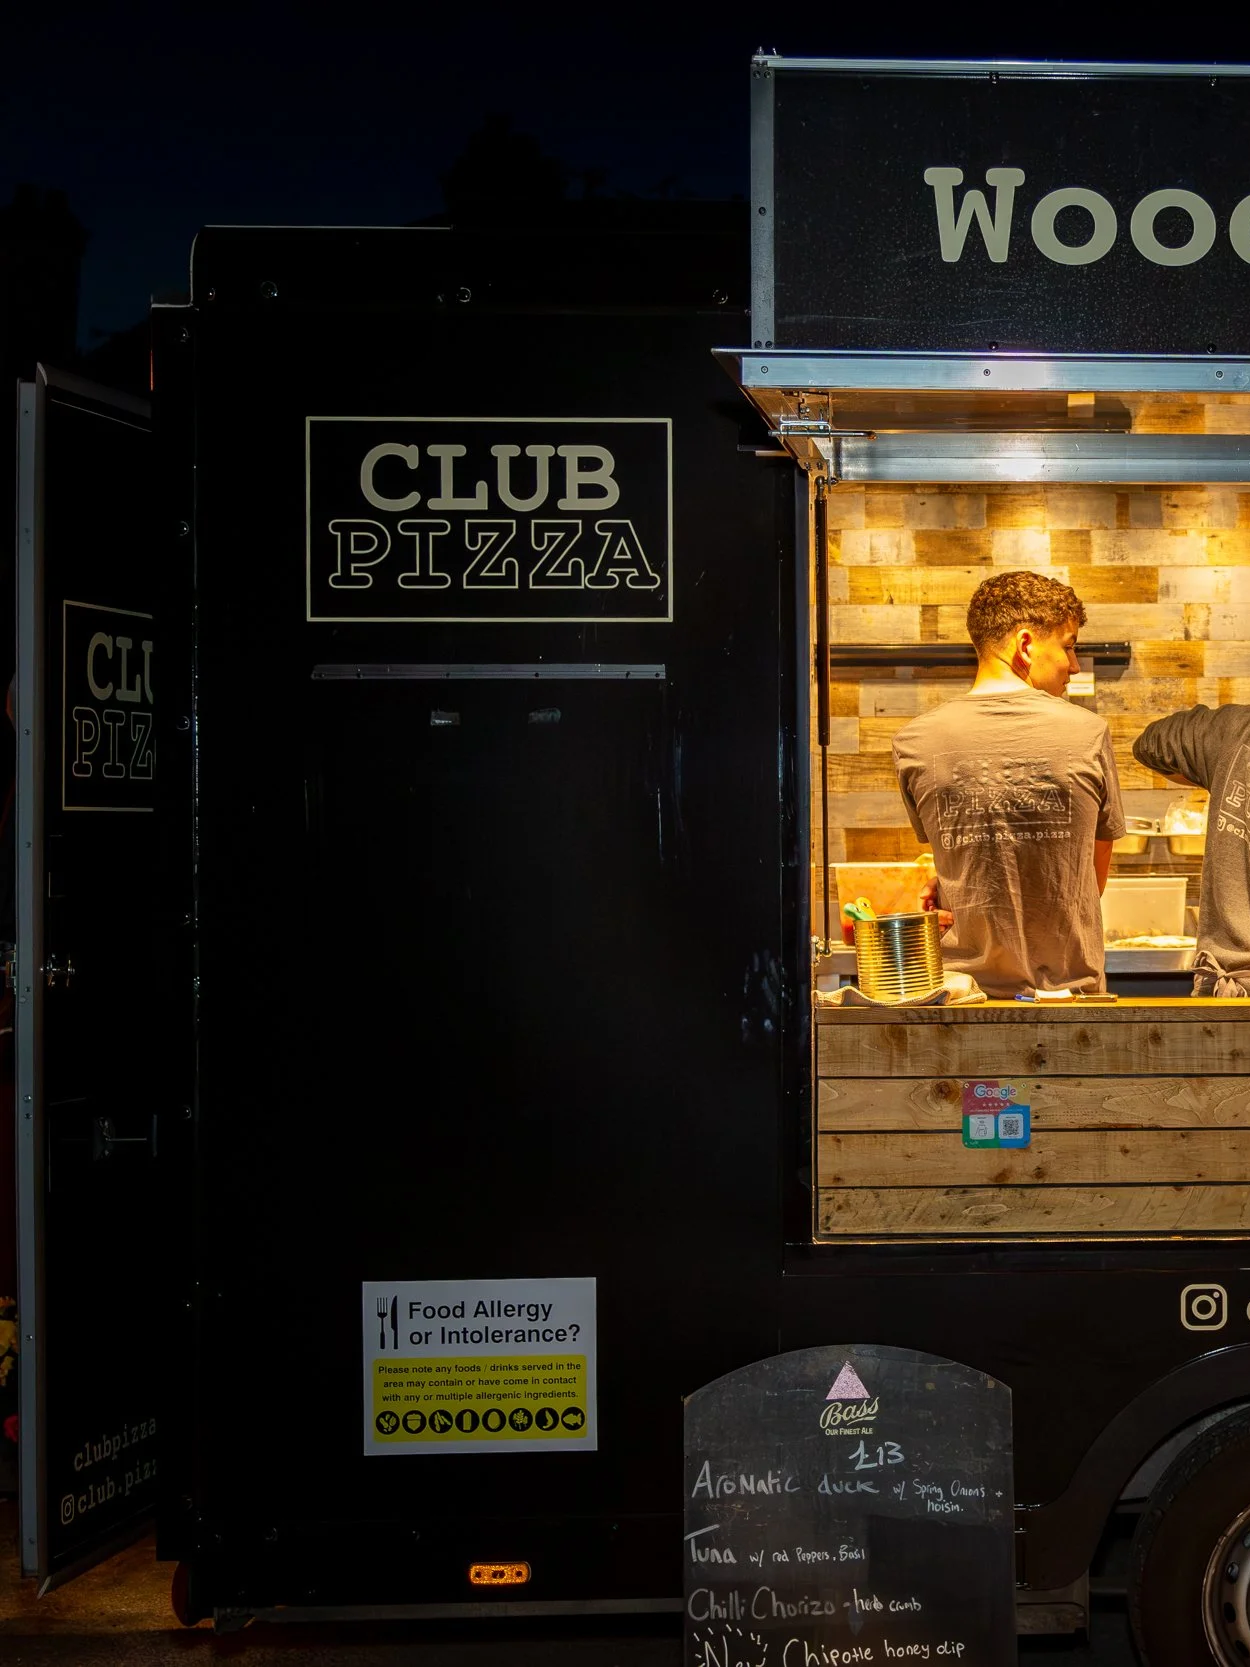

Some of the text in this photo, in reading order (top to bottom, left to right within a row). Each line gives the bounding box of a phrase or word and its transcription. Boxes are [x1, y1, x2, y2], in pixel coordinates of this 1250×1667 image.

[359, 442, 621, 512] CLUB
[328, 519, 661, 590] PIZZA
[72, 705, 156, 780] PIZ
[941, 787, 1066, 817] PIZZA
[974, 1084, 1017, 1100] Google
[408, 1300, 553, 1322] Food Allergy
[409, 1323, 581, 1345] or Intolerance?
[378, 1365, 409, 1374] Please
[435, 1366, 452, 1375] any
[454, 1364, 481, 1373] foods
[490, 1363, 519, 1372] drinks
[521, 1362, 553, 1371] served
[555, 1362, 564, 1370] in
[566, 1362, 581, 1370] the
[406, 1380, 426, 1389] may
[428, 1378, 463, 1387] contain
[478, 1378, 500, 1386] have
[503, 1378, 529, 1386] come
[531, 1376, 540, 1384] in
[542, 1376, 577, 1385] contact
[382, 1393, 401, 1402] with
[403, 1394, 421, 1403] any
[435, 1392, 473, 1402] multiple
[475, 1390, 522, 1401] allergenic
[524, 1389, 579, 1400] ingredients.
[819, 1397, 880, 1429] Bass
[848, 1439, 905, 1471] £13
[912, 1478, 944, 1502] Spring
[684, 1524, 737, 1565] Tuna
[772, 1548, 790, 1562] red
[687, 1588, 746, 1621] Chilli
[752, 1585, 836, 1619] Chorizo
[783, 1638, 874, 1667] Chipotle
[884, 1639, 930, 1660] honey
[936, 1641, 965, 1661] dip
